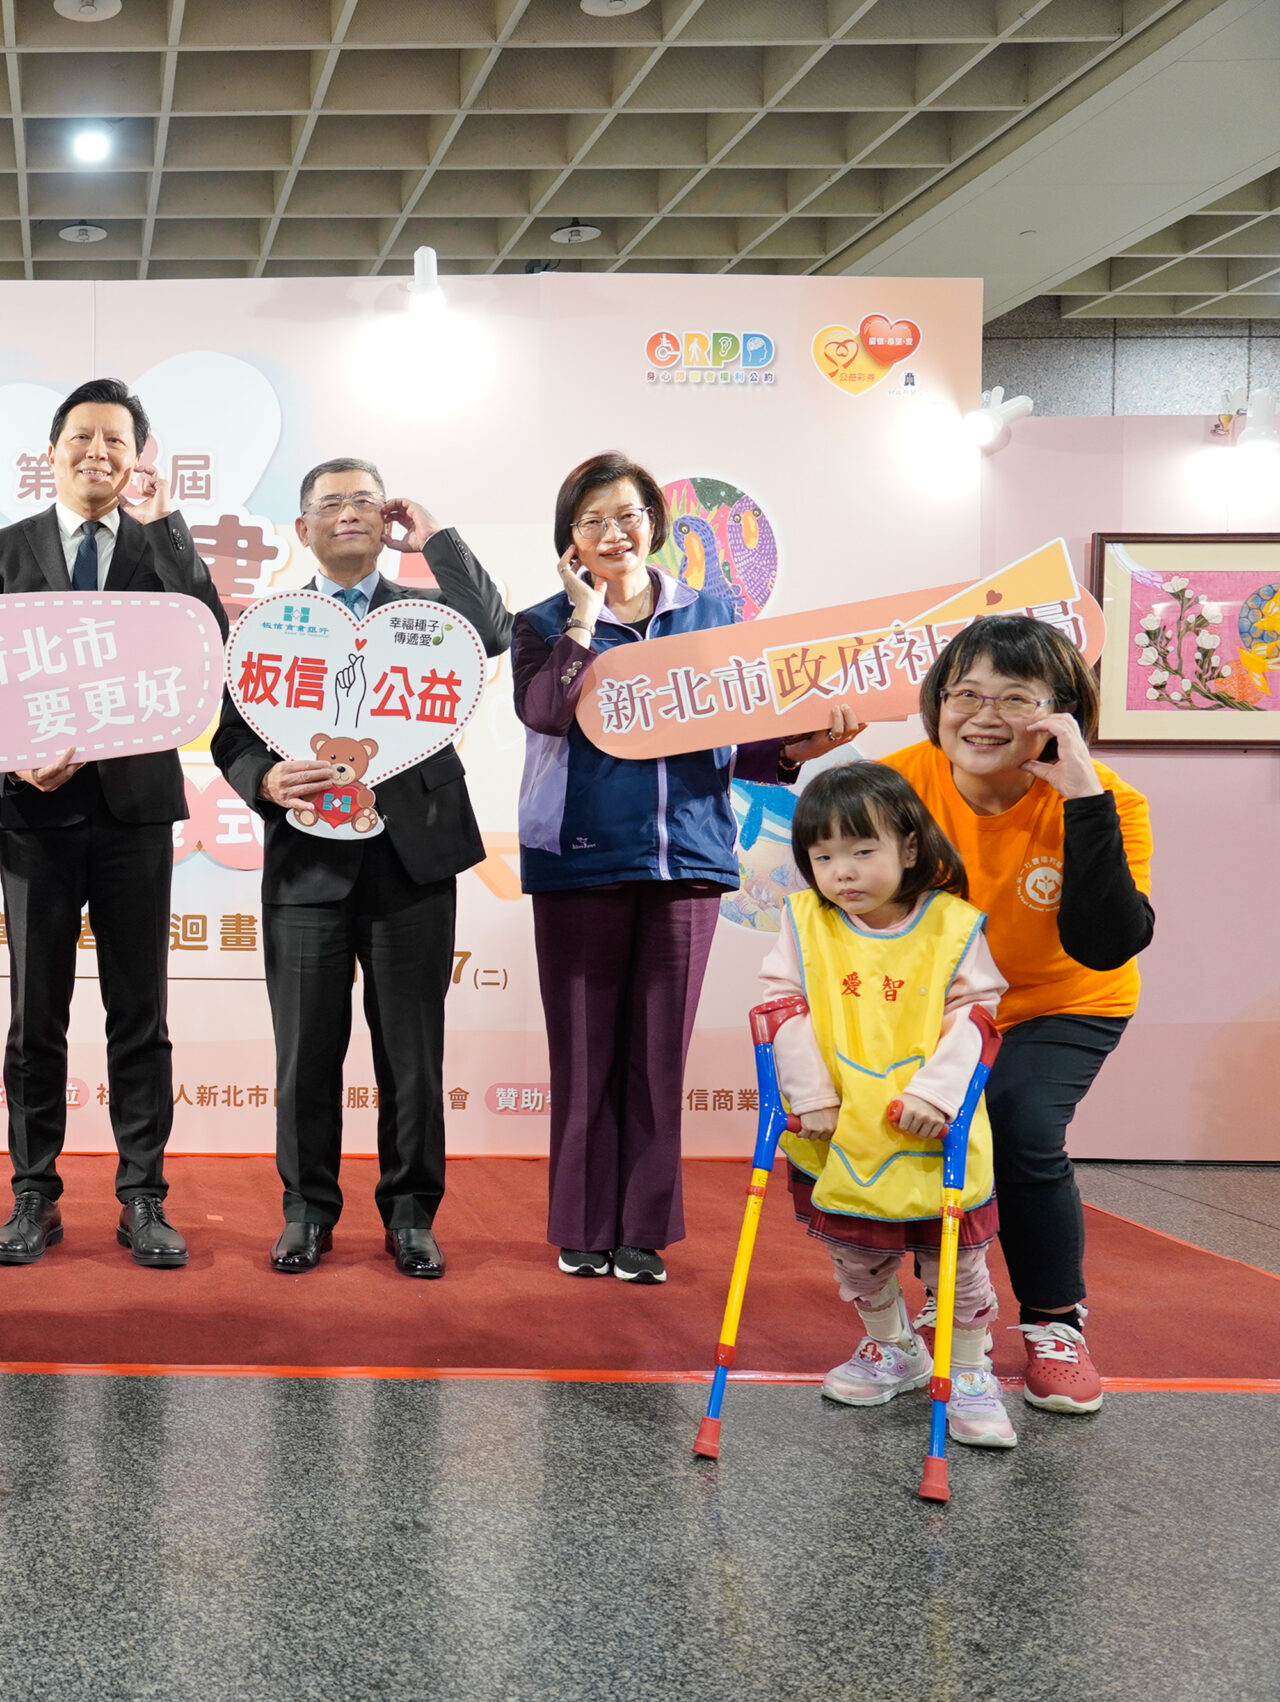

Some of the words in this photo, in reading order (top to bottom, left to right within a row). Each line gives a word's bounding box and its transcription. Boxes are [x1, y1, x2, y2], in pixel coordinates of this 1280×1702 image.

[646, 331, 774, 368] CRPD
[389, 617, 439, 632] 幸福種子
[394, 632, 431, 646] 傳遞愛
[238, 652, 328, 711] 板信
[370, 666, 462, 724] 公益
[23, 666, 186, 743] 要更好
[173, 1084, 277, 1108] 人新北市
[495, 1087, 551, 1112] 贊助
